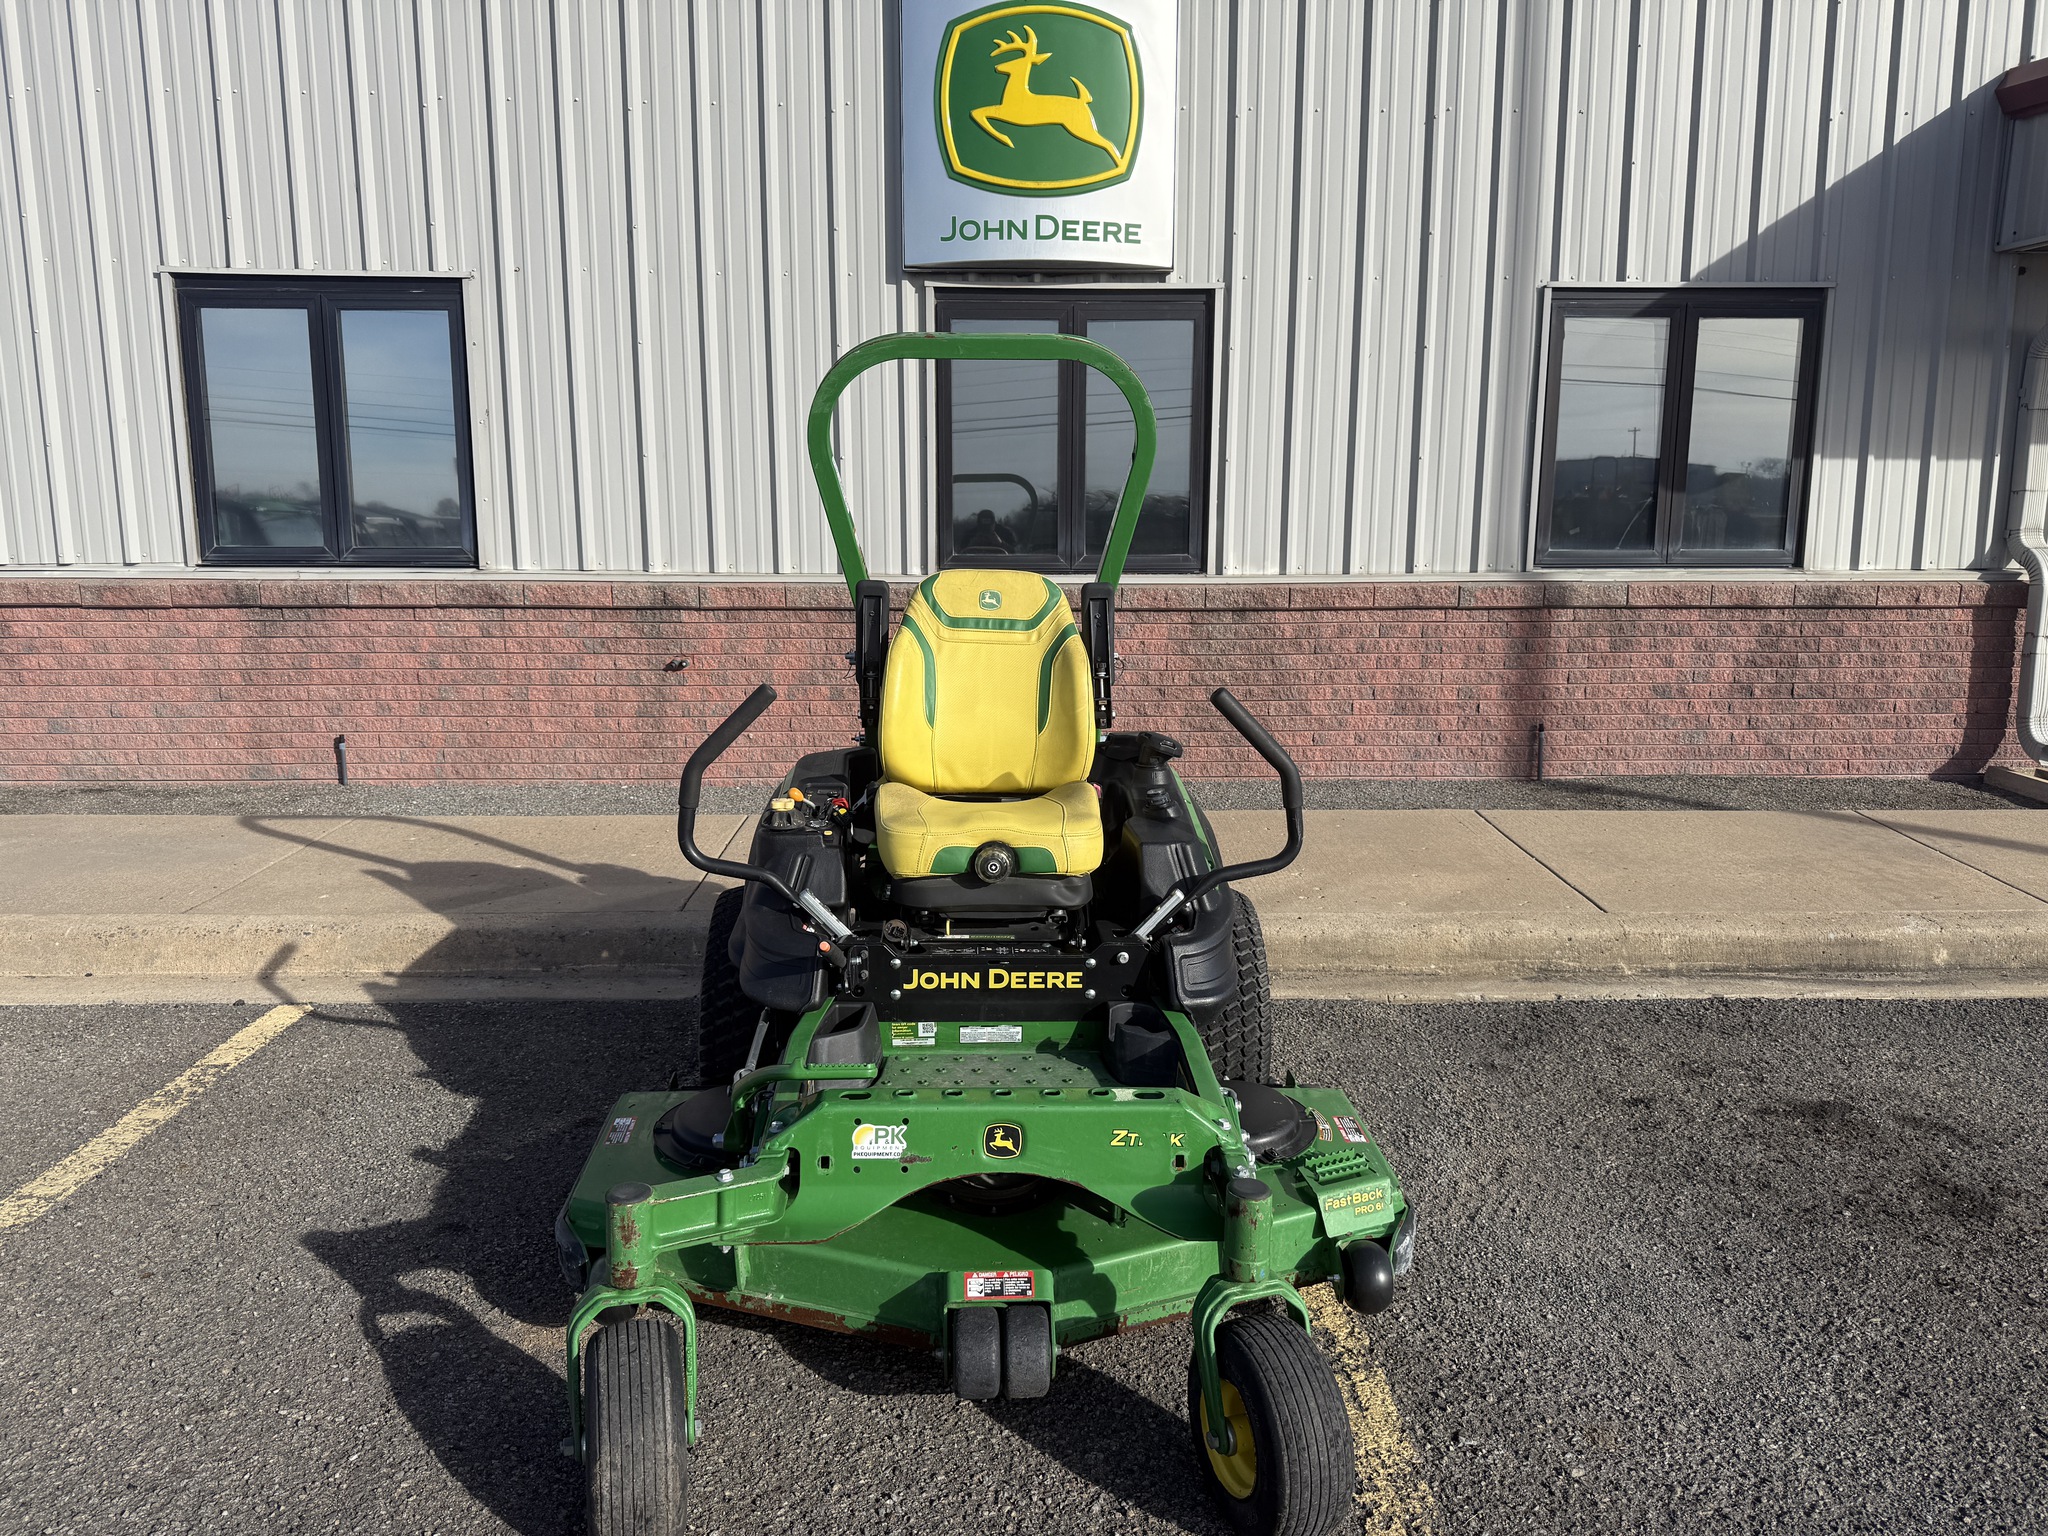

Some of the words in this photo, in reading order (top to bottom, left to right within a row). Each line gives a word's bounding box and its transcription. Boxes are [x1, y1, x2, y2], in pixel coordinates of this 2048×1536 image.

[940, 216, 1027, 242] JOHN
[1035, 214, 1142, 244] DEERE
[903, 968, 980, 989] JOHN
[988, 968, 1083, 989] DEERE
[1110, 1129, 1186, 1147] ZTK
[1355, 1203, 1374, 1216] PRO
